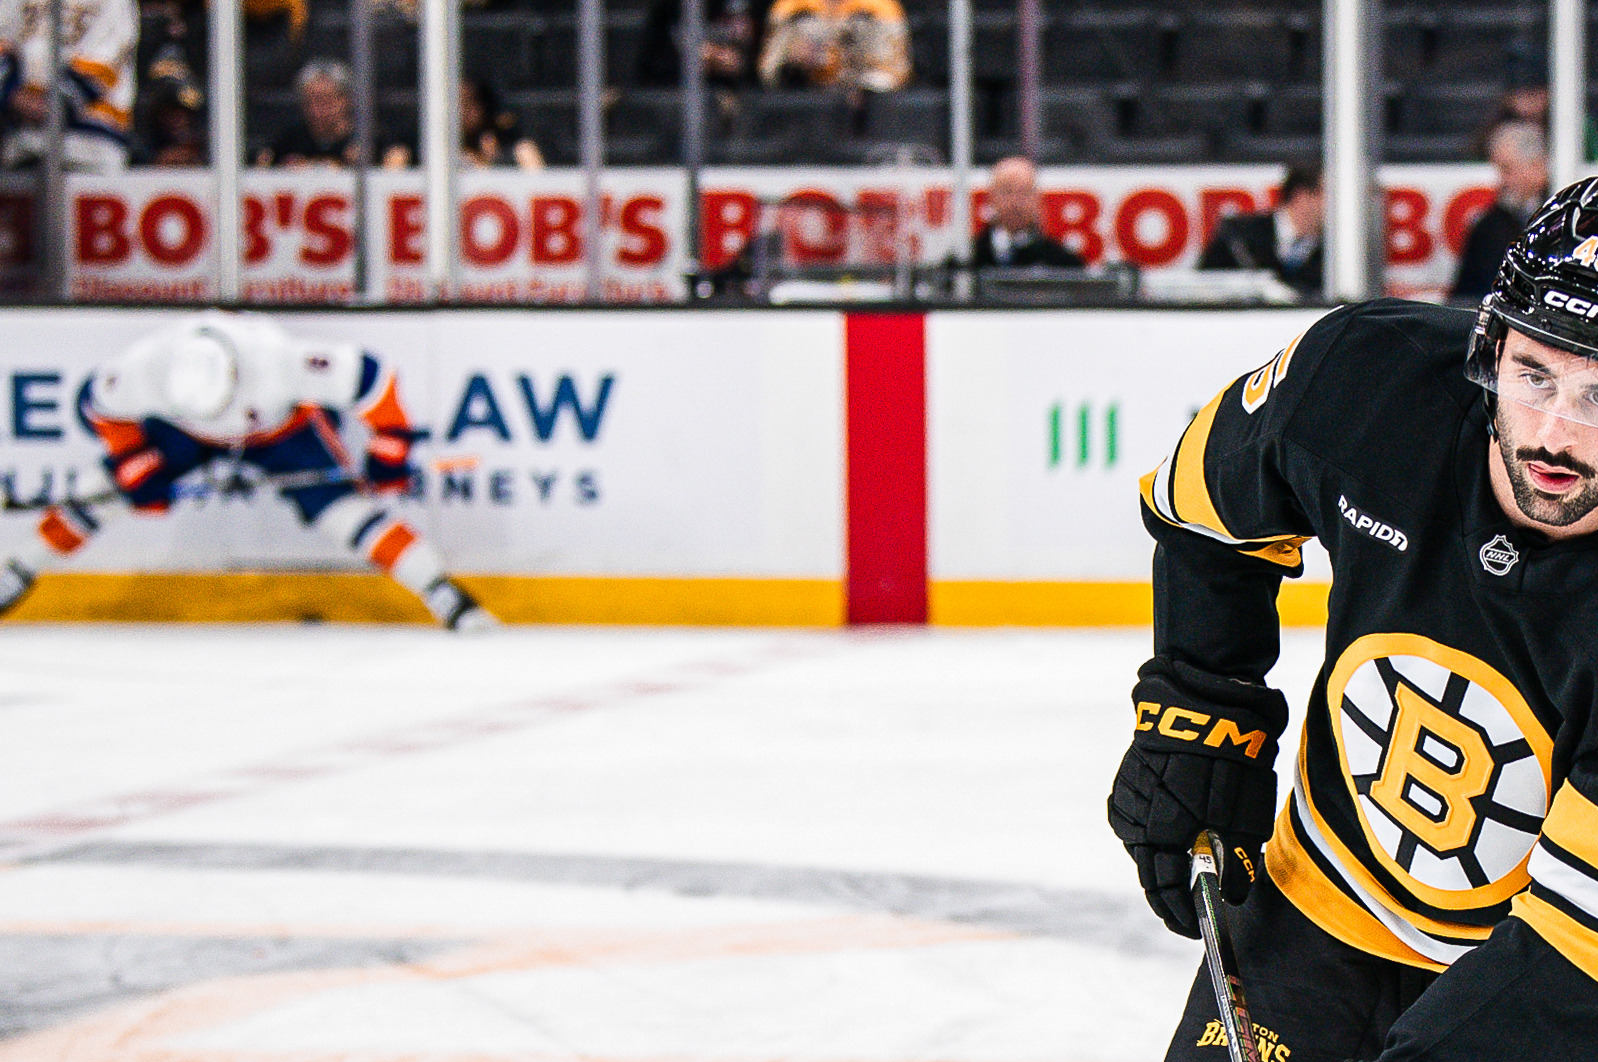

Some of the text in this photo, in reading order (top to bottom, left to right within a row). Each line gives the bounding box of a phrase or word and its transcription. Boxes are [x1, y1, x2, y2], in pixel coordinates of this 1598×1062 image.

[400, 374, 613, 442] AW
[1486, 551, 1510, 562] NHL
[1136, 701, 1267, 759] CCM
[1370, 681, 1495, 852] B
[1199, 855, 1213, 864] 45
[1234, 846, 1256, 883] CCM
